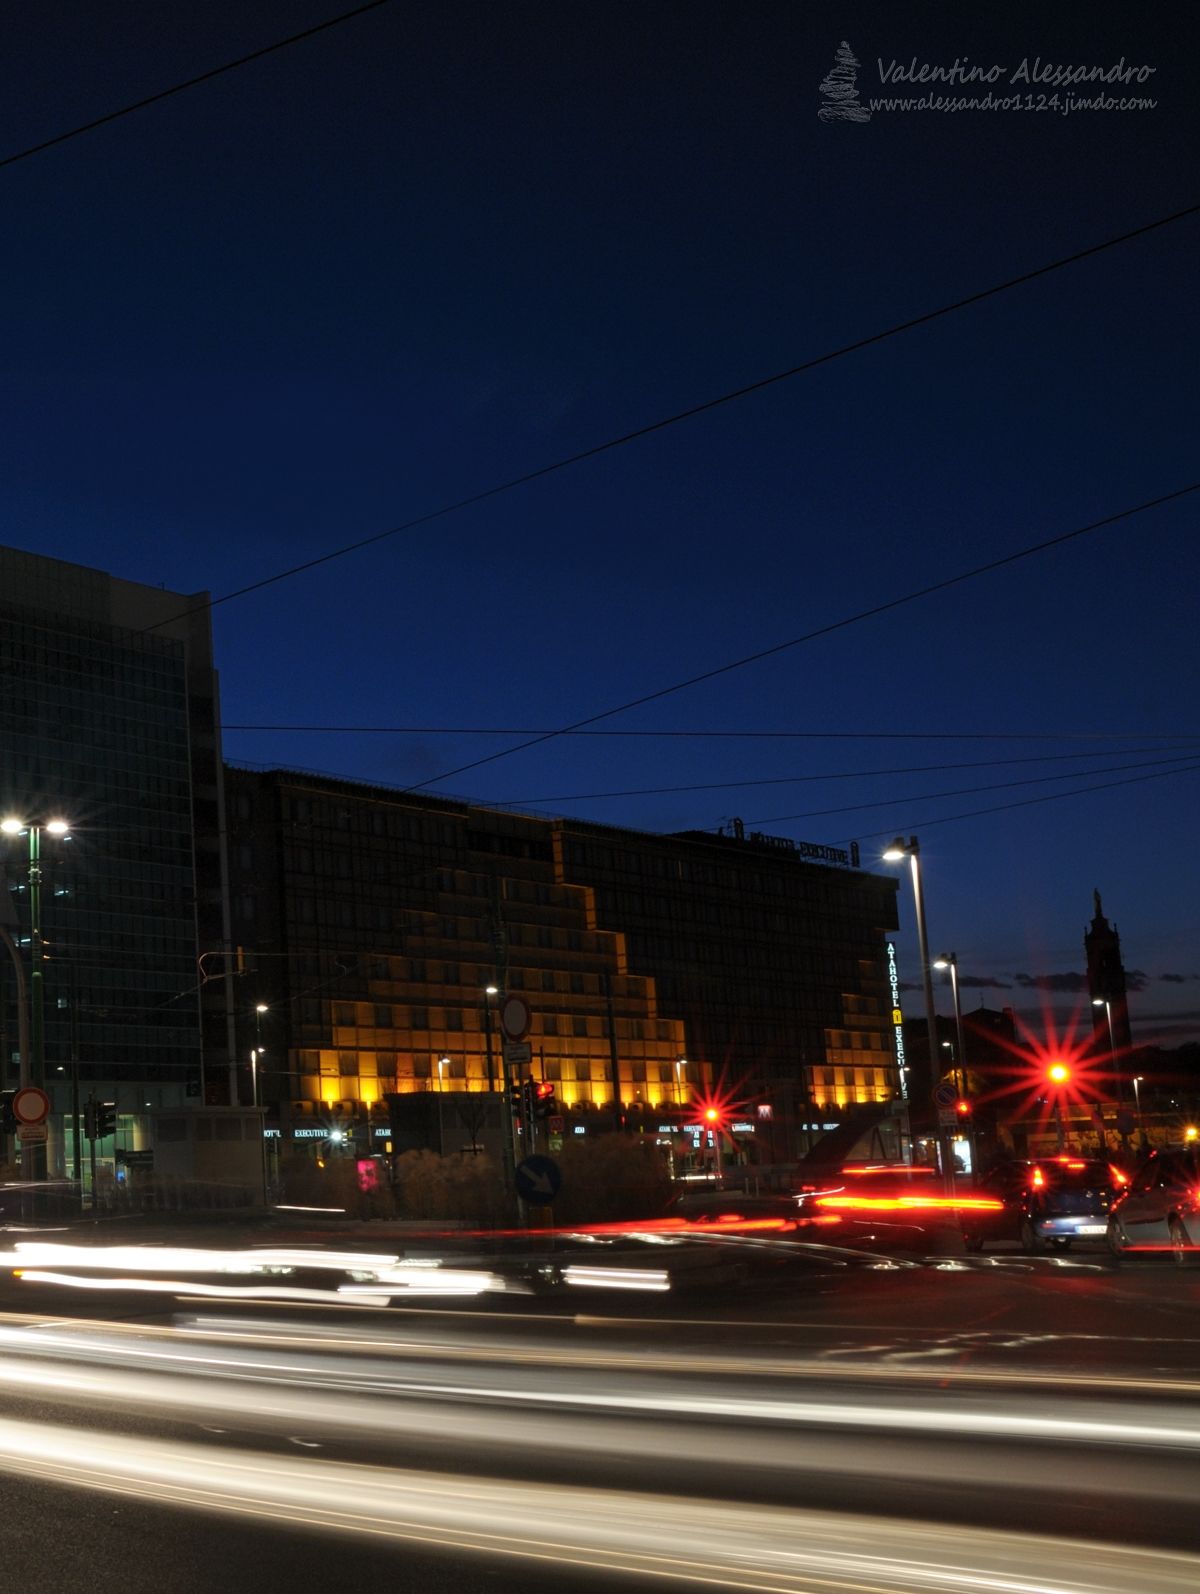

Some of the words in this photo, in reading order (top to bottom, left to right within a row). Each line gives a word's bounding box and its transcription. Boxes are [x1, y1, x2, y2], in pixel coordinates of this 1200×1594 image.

[887, 942, 900, 1007] ATAHOTEL
[895, 1026, 908, 1099] EXECUVE
[294, 1129, 329, 1138] EXECUTIVE
